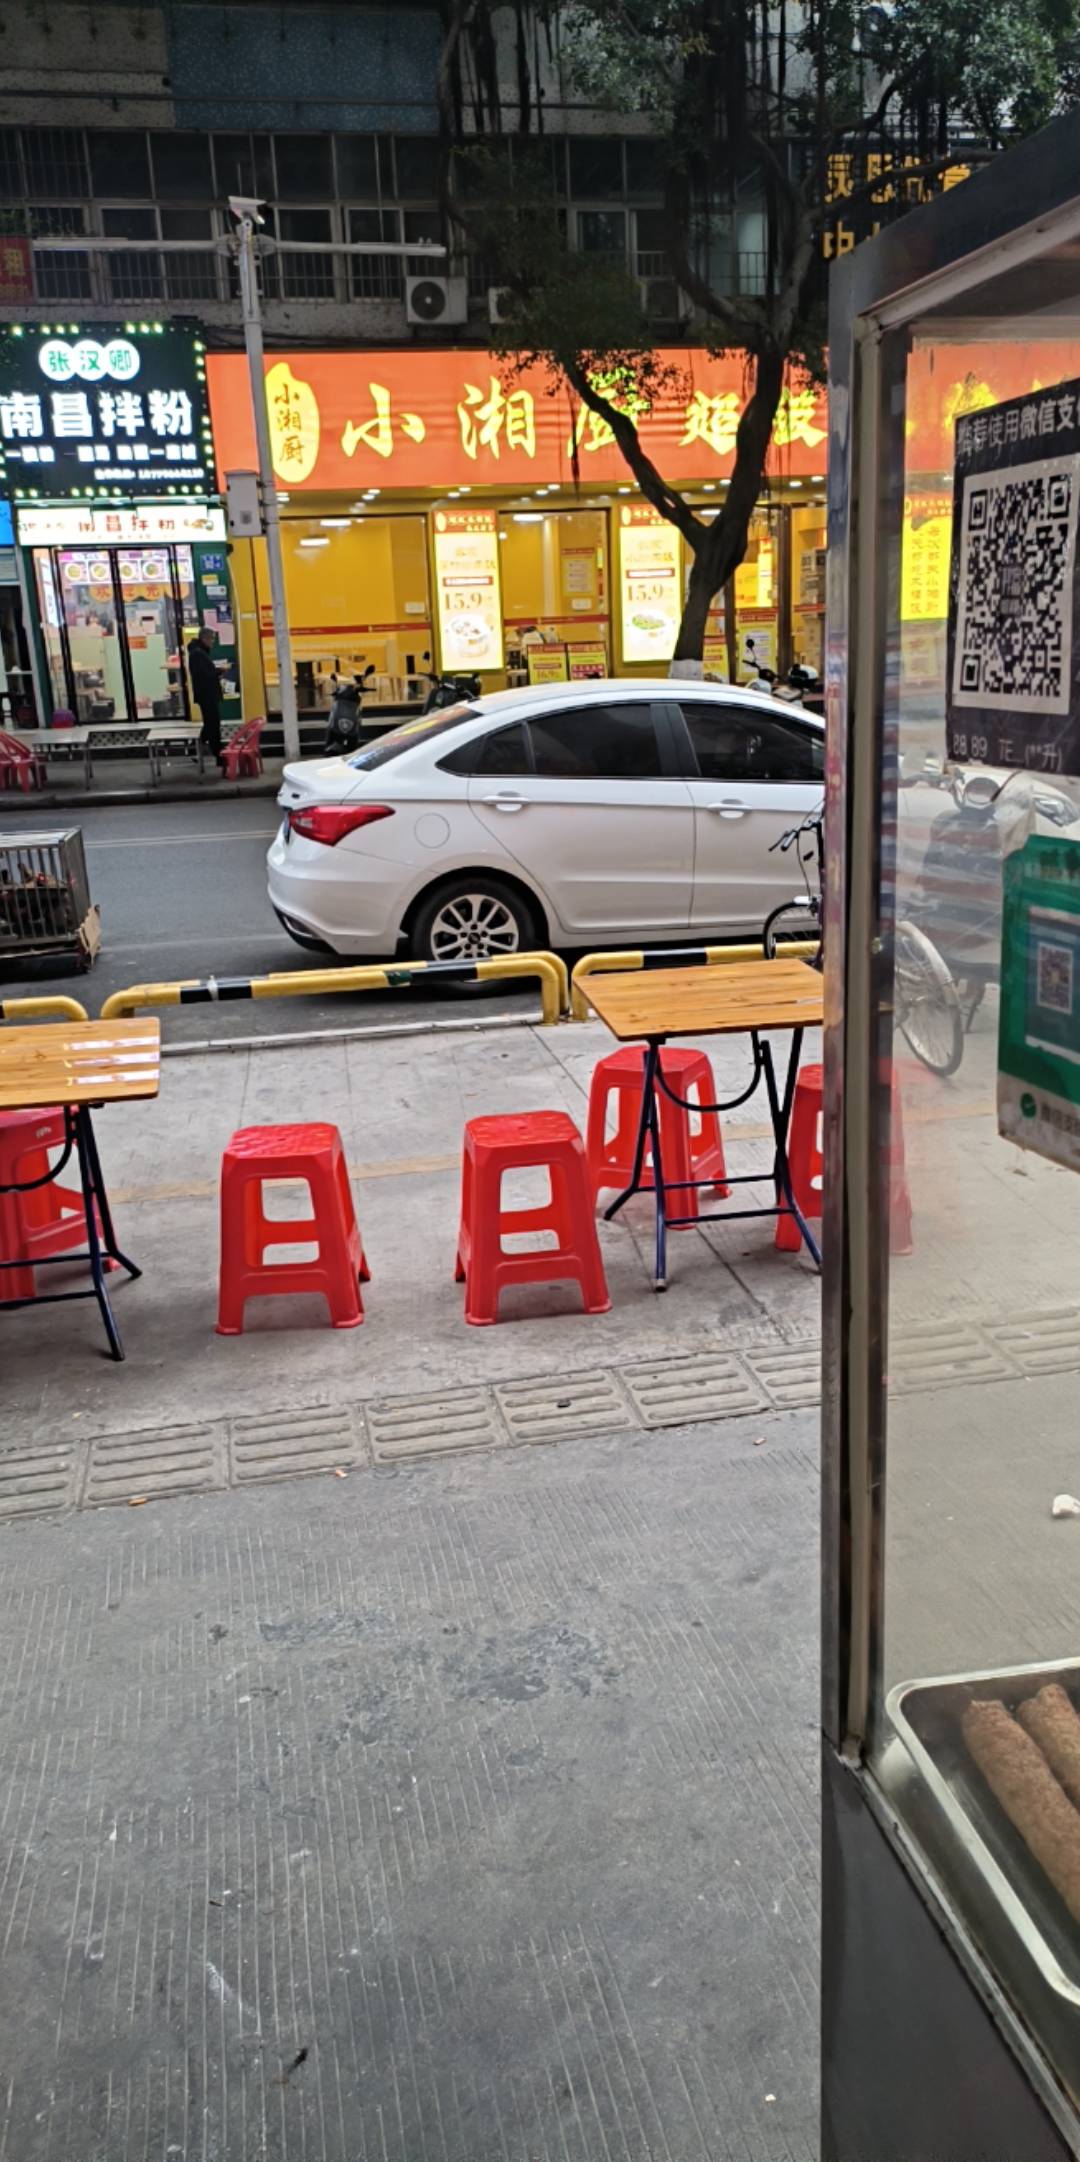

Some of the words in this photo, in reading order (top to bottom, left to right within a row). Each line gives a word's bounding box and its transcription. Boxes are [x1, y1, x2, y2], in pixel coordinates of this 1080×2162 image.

[48, 350, 131, 372] 张汉卿
[0, 390, 192, 438] 南昌拌粉
[274, 384, 304, 464] 小湘厨
[957, 393, 1080, 457] 推荐使用微信支
[445, 592, 482, 611] 15.9
[627, 582, 664, 602] 15.9
